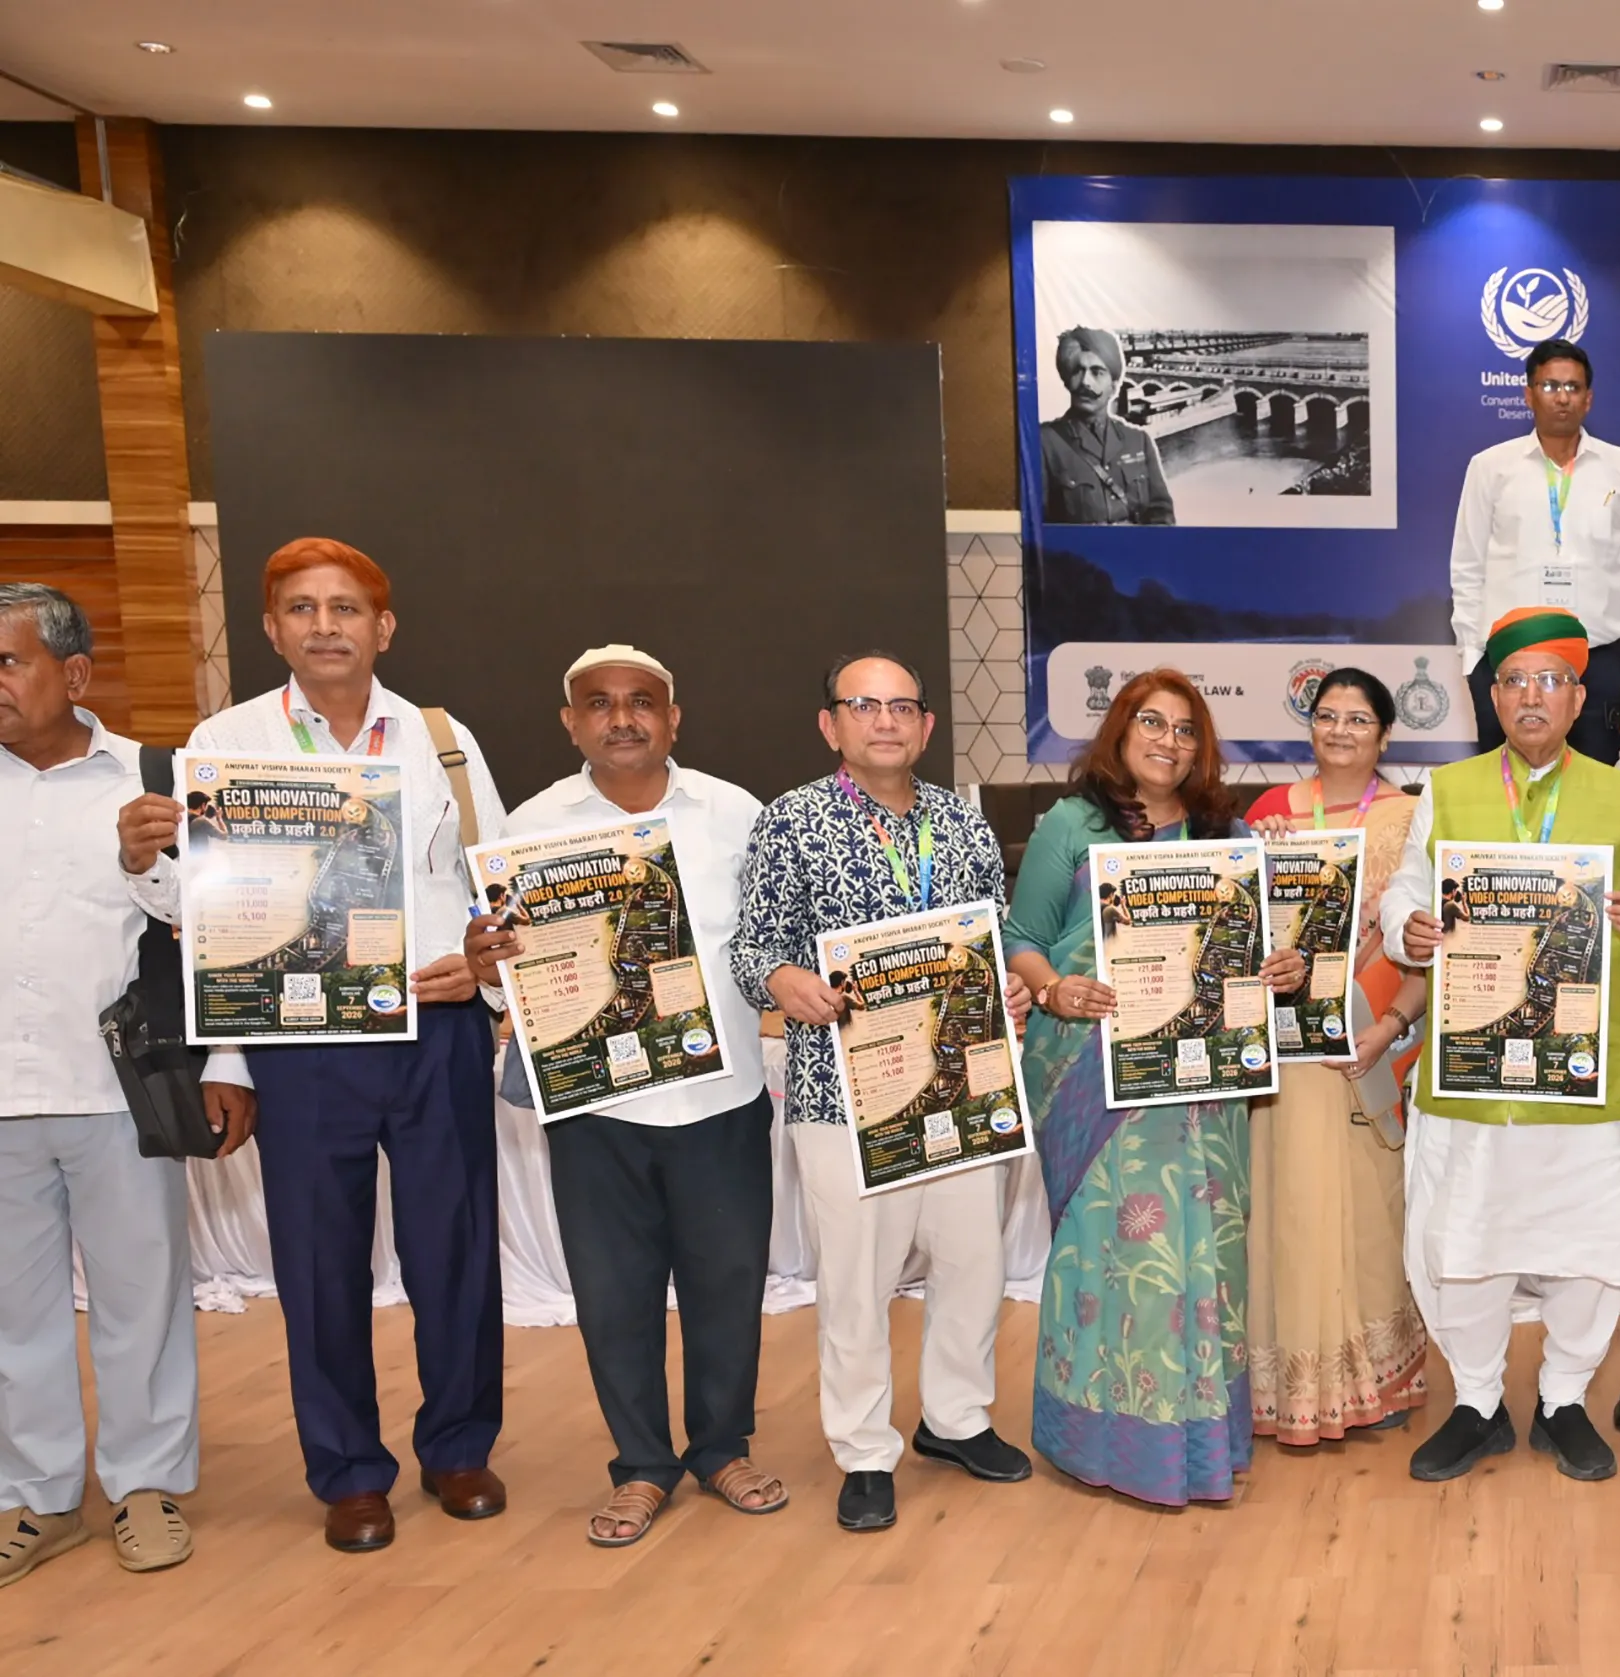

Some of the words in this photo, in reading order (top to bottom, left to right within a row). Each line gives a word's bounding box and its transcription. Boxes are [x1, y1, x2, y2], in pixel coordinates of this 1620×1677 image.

[1205, 686, 1231, 695] LAW
[1235, 686, 1244, 695] &
[223, 790, 250, 805] ECO
[255, 790, 339, 808] INNOVATION
[225, 807, 259, 819] VIDEO
[264, 807, 341, 822] COMPETITION
[231, 821, 265, 838] प्रकृति
[269, 821, 282, 834] के
[284, 822, 315, 837] प्रहरी
[320, 826, 335, 836] 2.0
[516, 872, 542, 891] ECO
[544, 857, 620, 885] INNOVATION
[522, 886, 554, 904] VIDEO
[556, 874, 626, 897] COMPETITION
[1125, 878, 1146, 894] ECO
[1150, 875, 1214, 891] INNOVATION
[1468, 877, 1488, 891] ECO
[1492, 877, 1556, 892] INNOVATION
[531, 899, 561, 918] प्रकृति
[563, 897, 575, 909] के
[578, 891, 604, 907] प्रहरी
[608, 890, 623, 902] 2.0
[1128, 893, 1154, 906] VIDEO
[1157, 890, 1216, 903] COMPETITION
[1469, 892, 1494, 904] VIDEO
[1497, 892, 1557, 905] COMPETITION
[1472, 904, 1498, 919] प्रकृति
[1500, 905, 1510, 917] के
[1512, 905, 1535, 919] प्रहरी
[1539, 909, 1551, 918] 2.0
[855, 959, 877, 978] ECO
[880, 945, 945, 971] INNOVATION
[860, 973, 886, 990] VIDEO
[888, 961, 949, 983] COMPETITION
[866, 986, 892, 1004] प्रकृति
[894, 984, 905, 995] के
[906, 977, 929, 993] प्रहरी
[933, 977, 946, 987] 2.0
